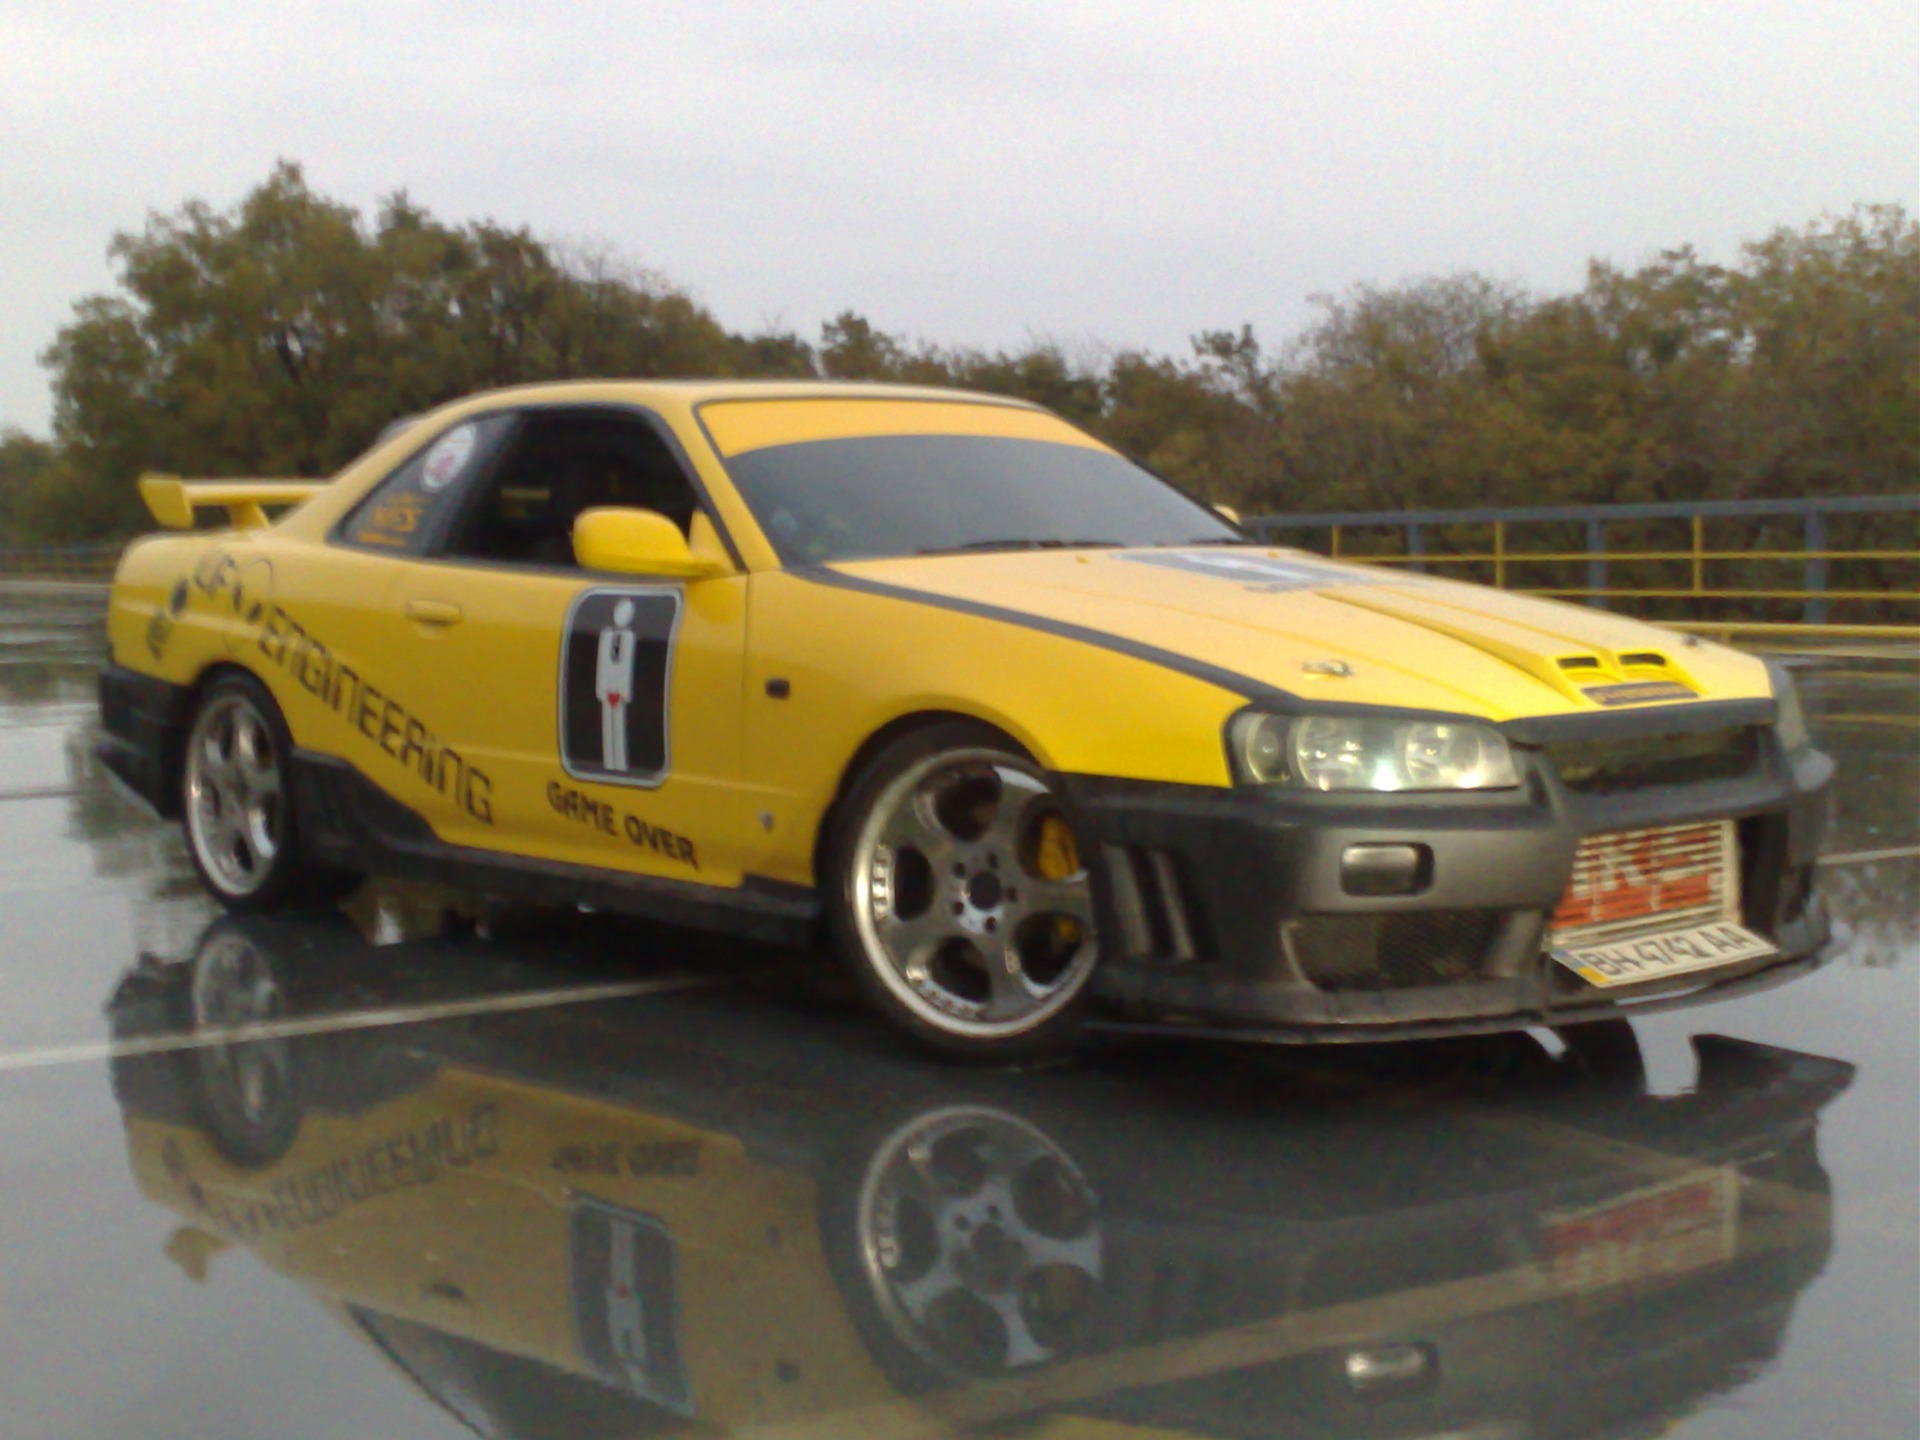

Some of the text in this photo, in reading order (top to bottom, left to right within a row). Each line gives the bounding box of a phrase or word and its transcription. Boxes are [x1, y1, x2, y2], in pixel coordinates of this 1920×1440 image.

[546, 781, 701, 872] GAME OVER
[1698, 926, 1754, 954] AA
